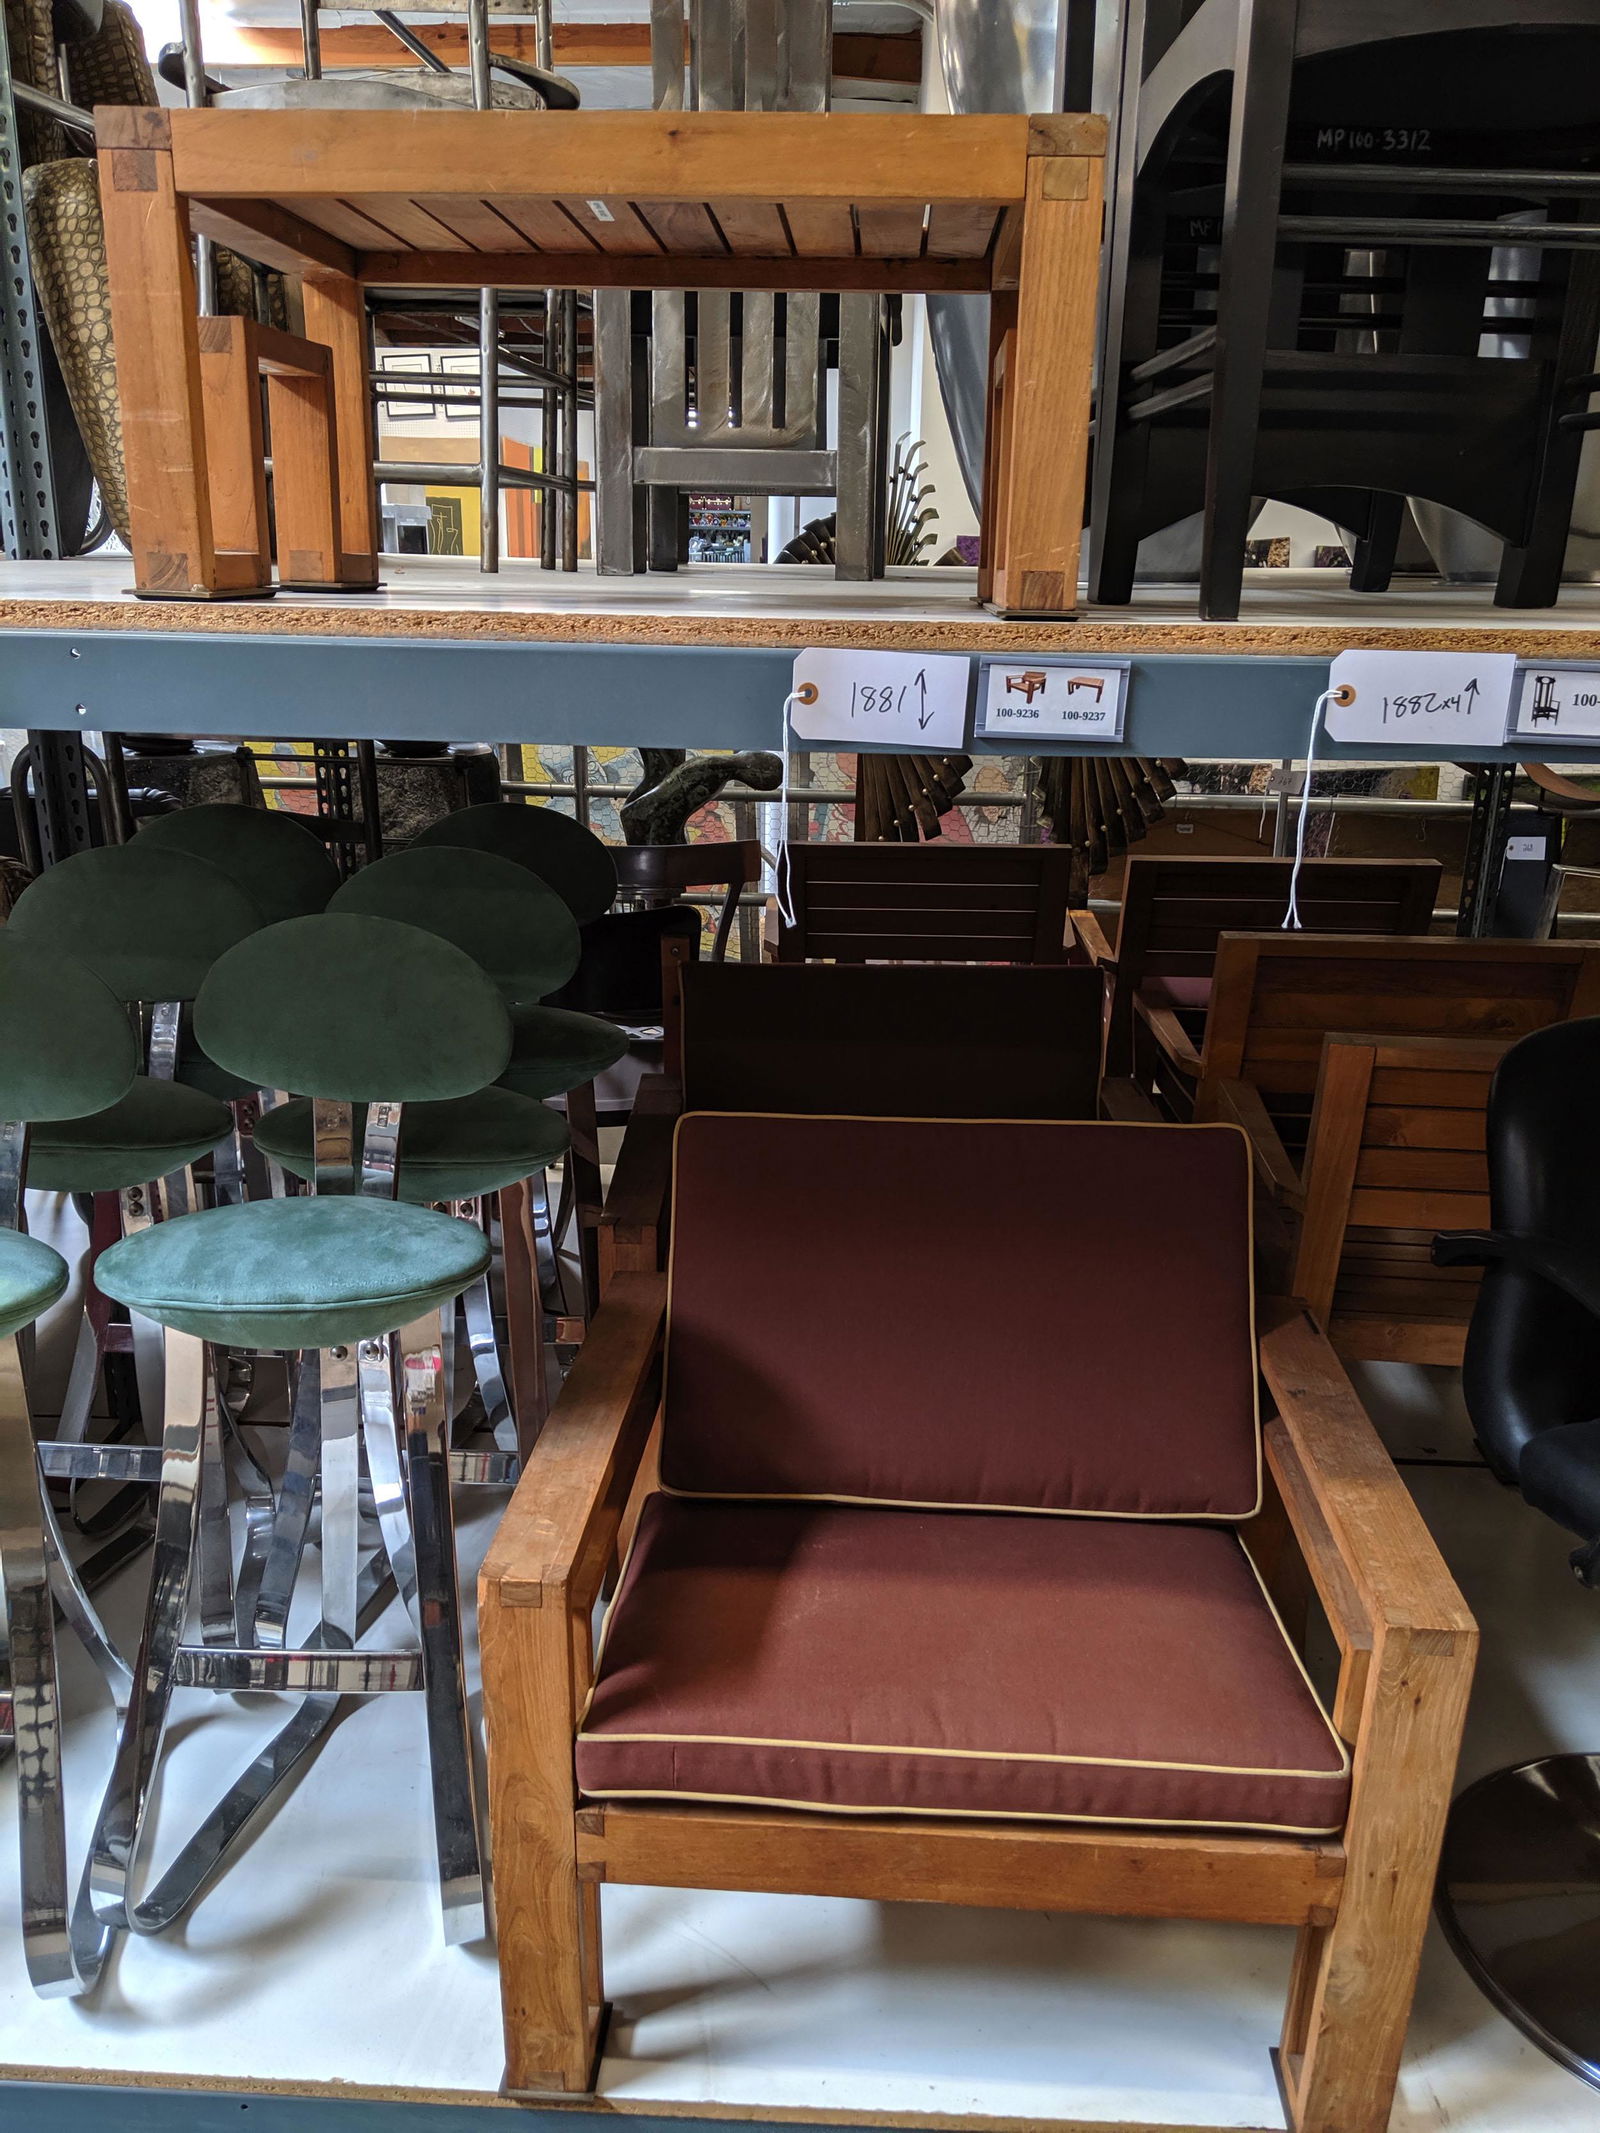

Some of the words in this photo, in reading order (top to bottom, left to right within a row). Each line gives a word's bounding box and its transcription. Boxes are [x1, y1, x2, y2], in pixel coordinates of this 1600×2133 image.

[1316, 128, 1345, 151] MP
[851, 681, 907, 718] 1881
[996, 708, 1040, 719] 100-9236
[1062, 710, 1106, 721] 100-9237
